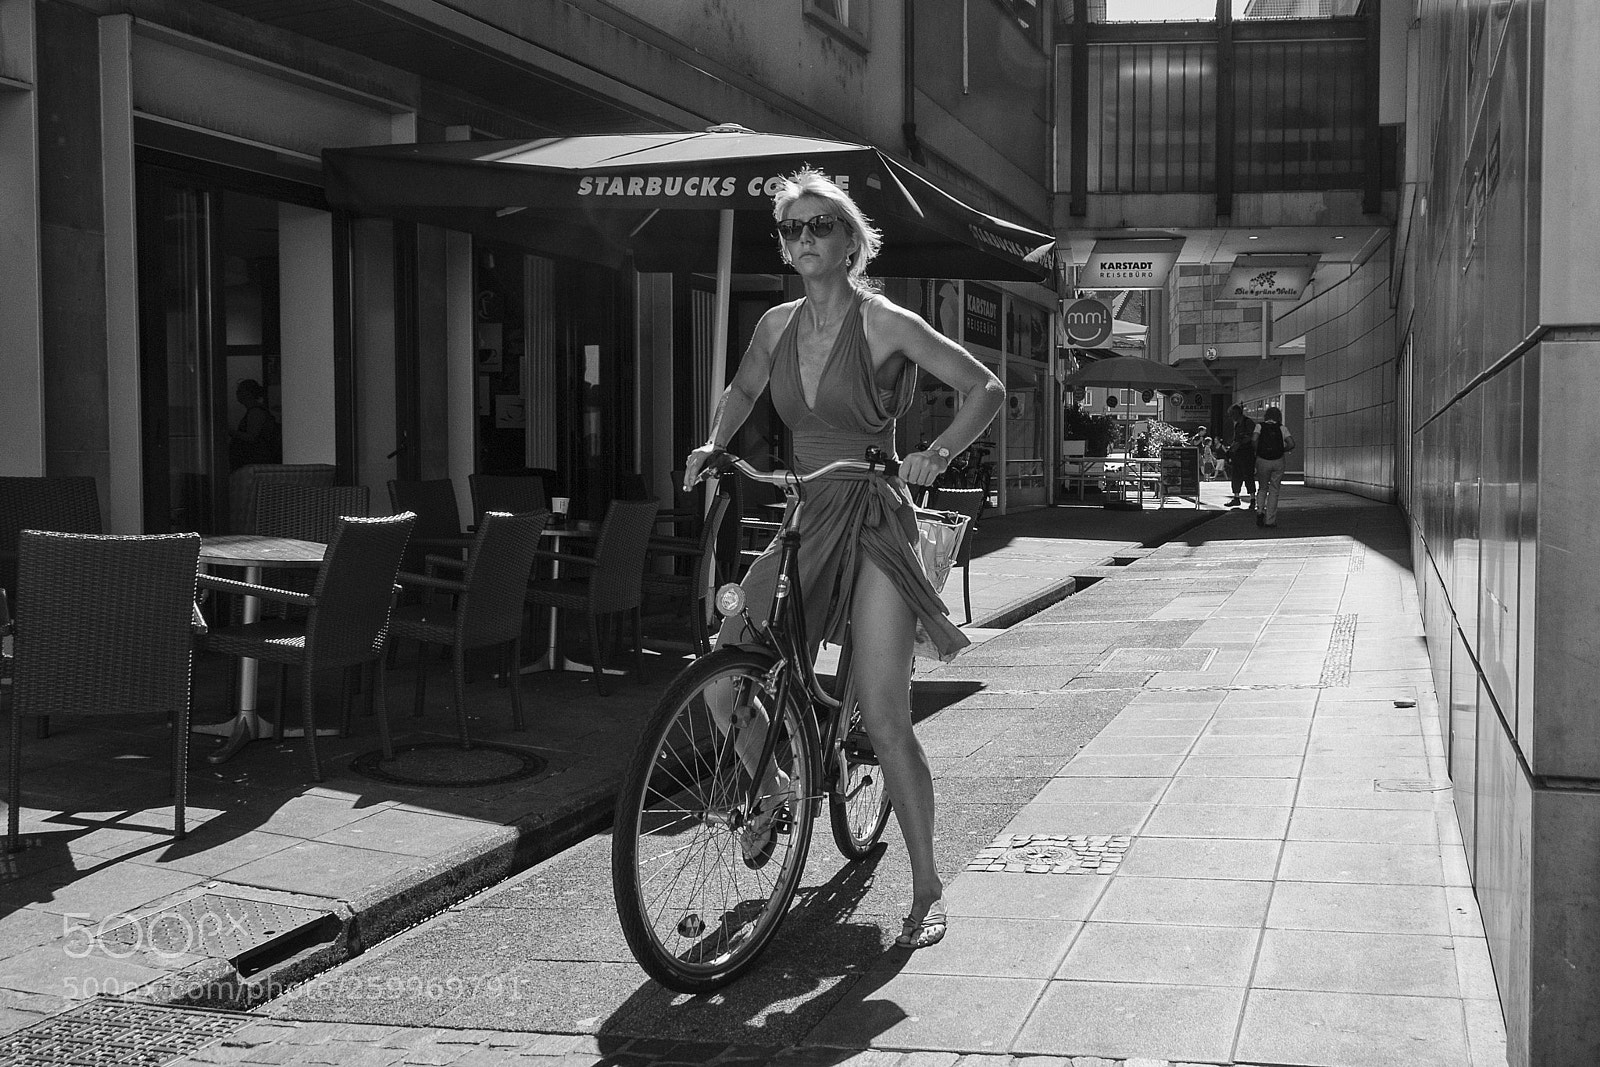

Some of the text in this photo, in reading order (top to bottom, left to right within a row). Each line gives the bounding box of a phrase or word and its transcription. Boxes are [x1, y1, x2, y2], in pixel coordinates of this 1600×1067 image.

[577, 176, 737, 197] STARBUCKS
[1100, 262, 1153, 270] KARSTADT
[967, 293, 997, 320] KARSTADT
[1067, 309, 1107, 324] mm!
